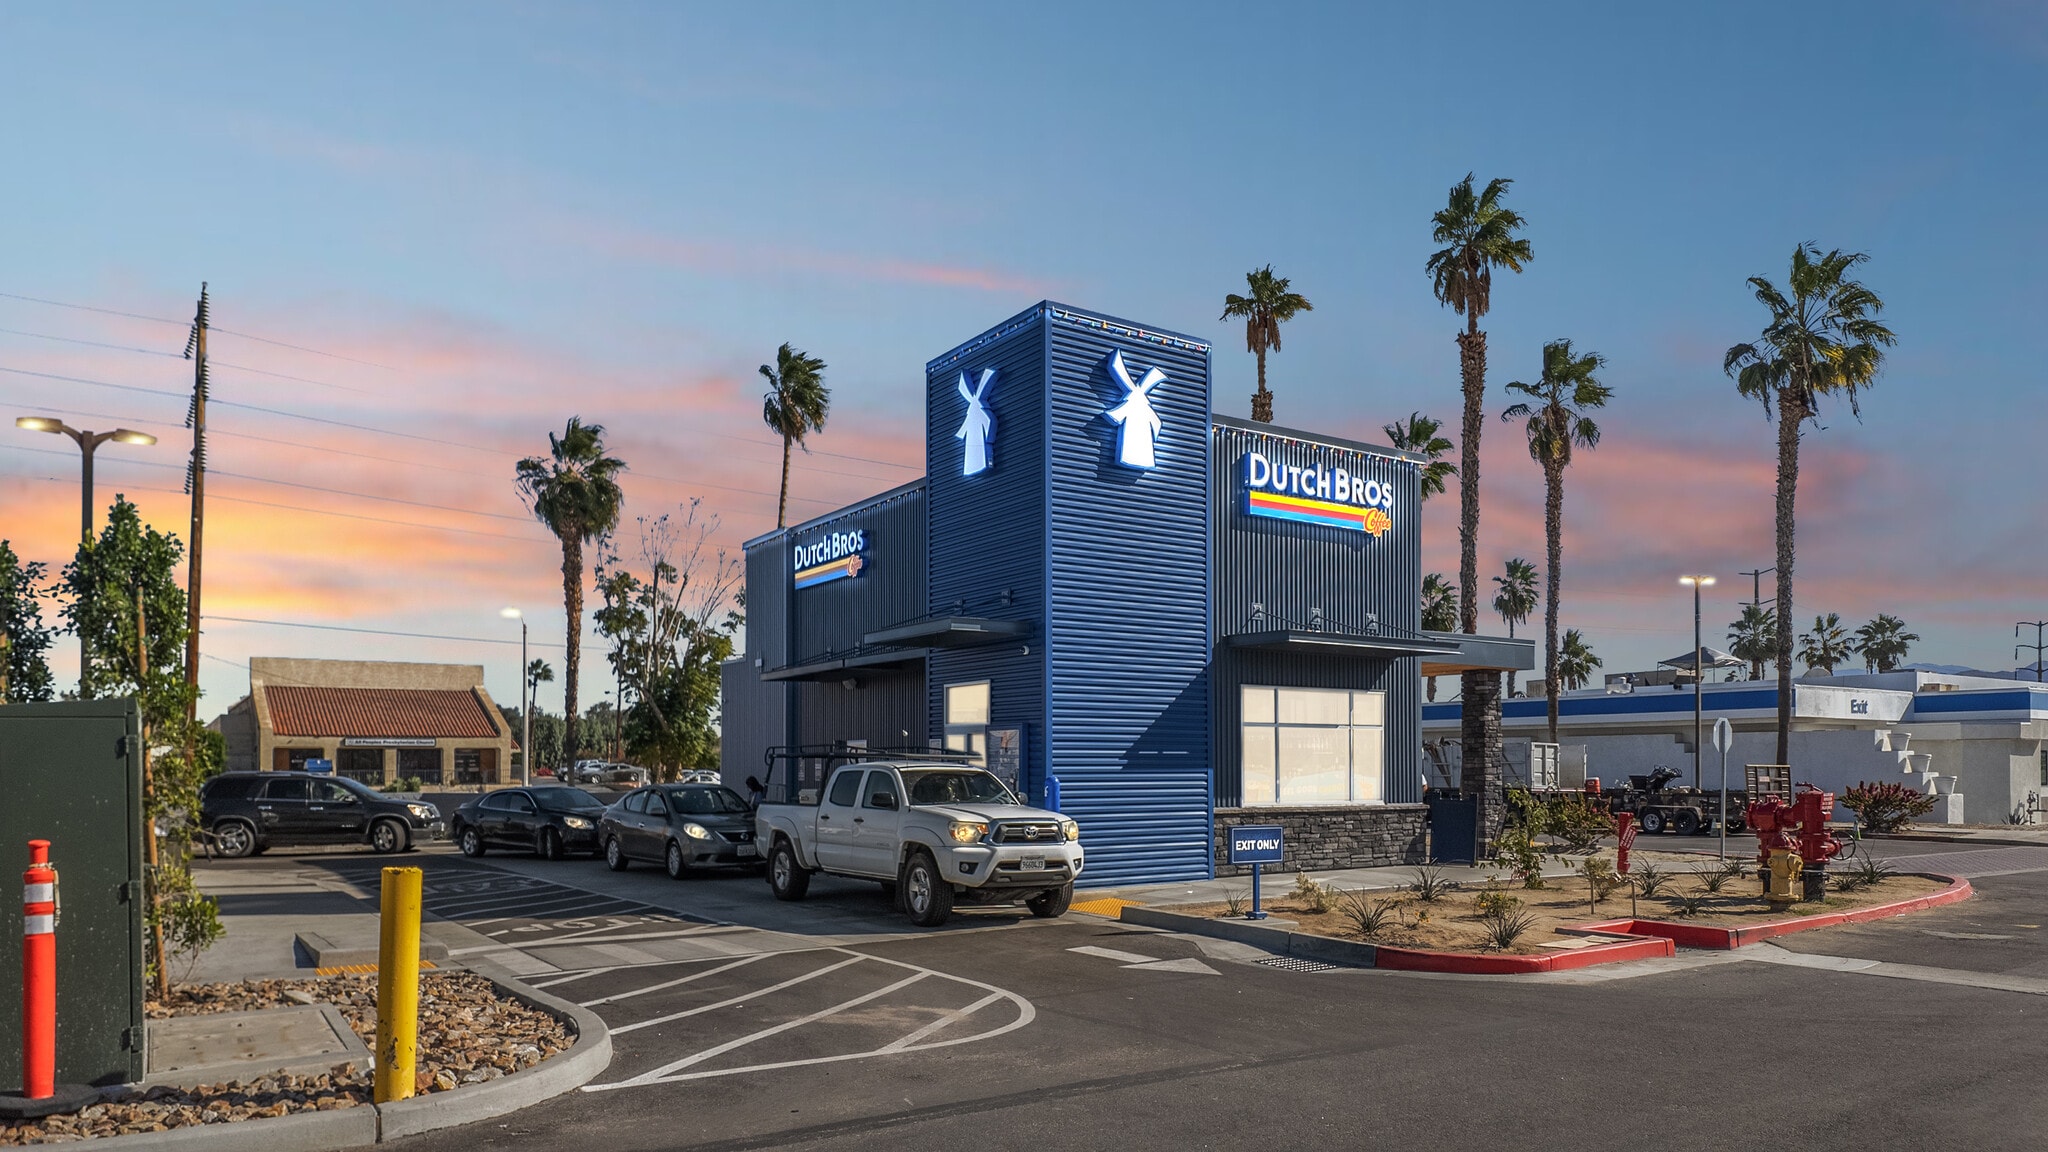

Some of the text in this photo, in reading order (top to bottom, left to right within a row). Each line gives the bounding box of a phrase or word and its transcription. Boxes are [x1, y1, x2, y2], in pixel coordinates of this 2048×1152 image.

[1250, 452, 1393, 508] DUTCH BROS
[1363, 508, 1393, 537] Coffee
[794, 535, 830, 570] DUTCH
[832, 529, 864, 559] BROS
[1850, 699, 1869, 715] Exit
[1235, 839, 1280, 850] EXIT ONLY
